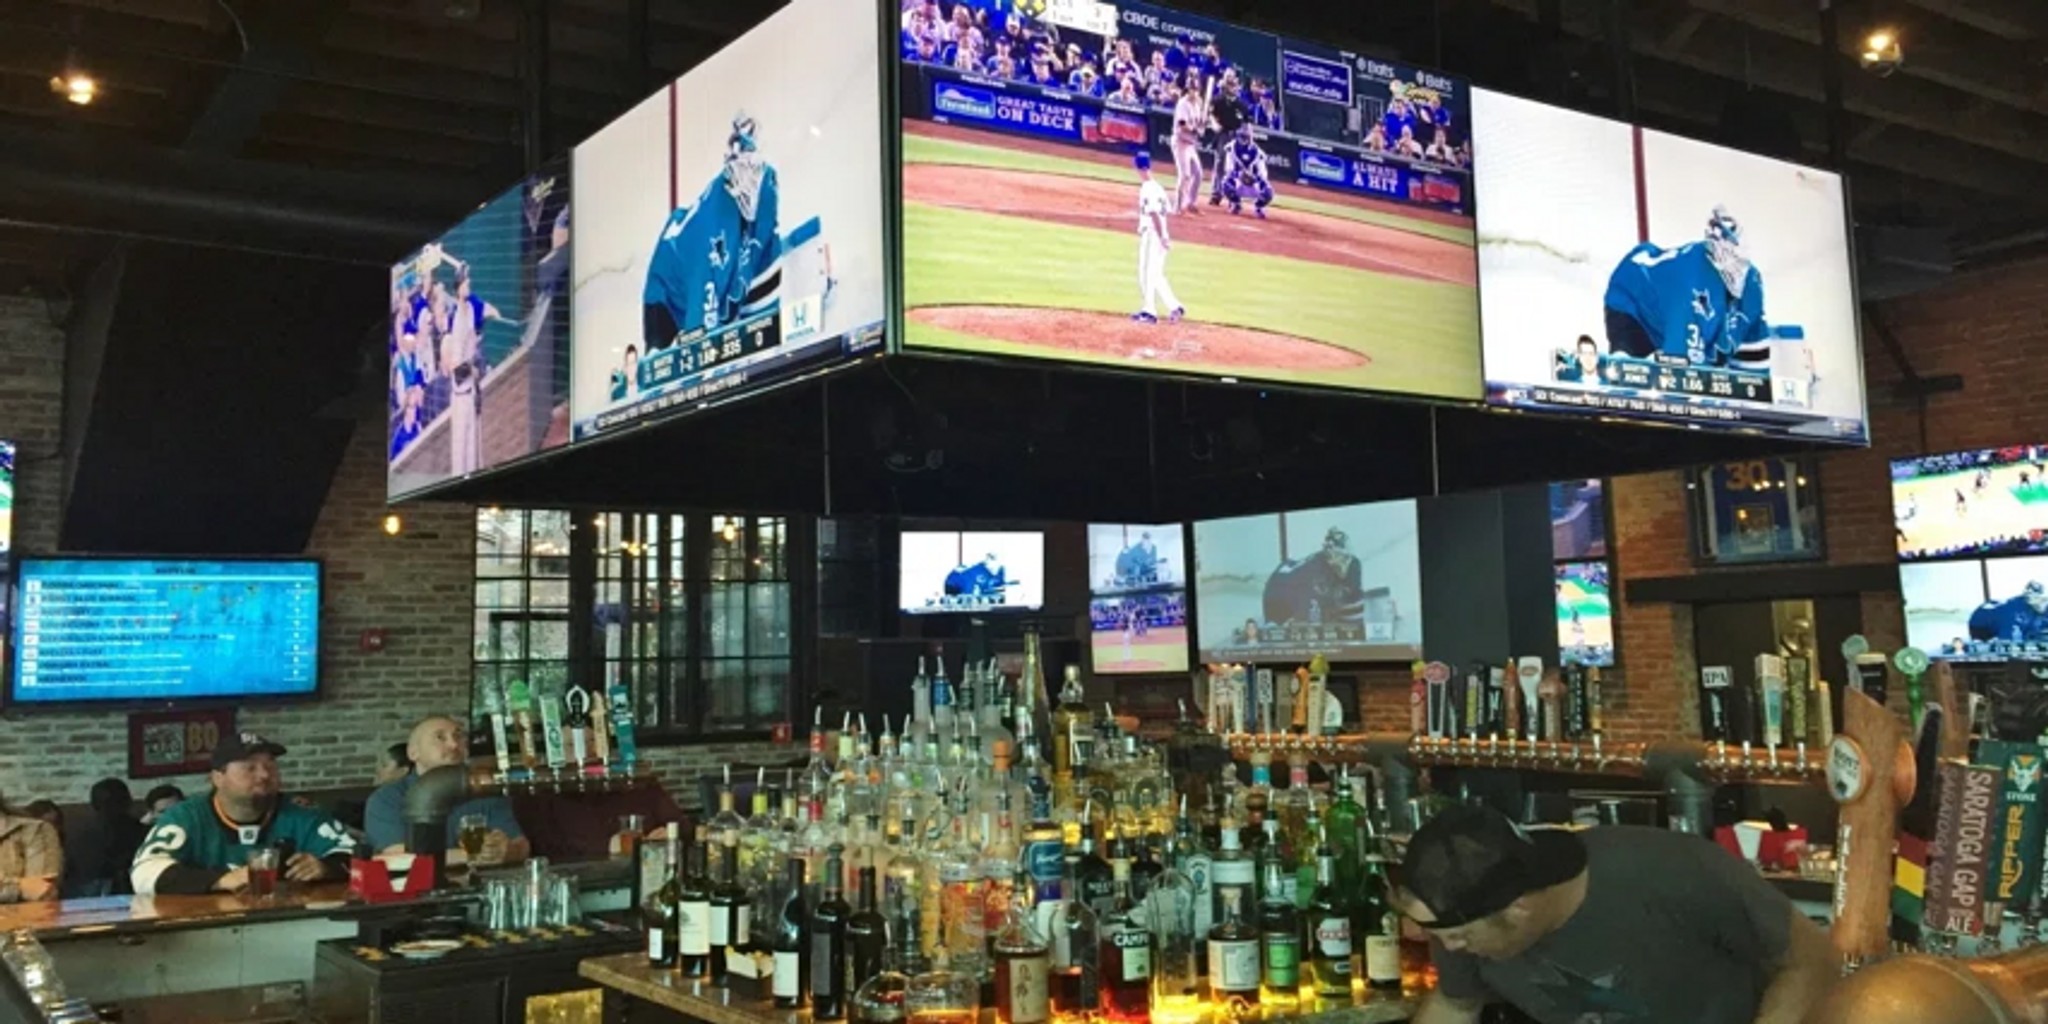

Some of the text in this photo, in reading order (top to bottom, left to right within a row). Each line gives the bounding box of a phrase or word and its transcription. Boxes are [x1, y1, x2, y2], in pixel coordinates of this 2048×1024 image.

[1122, 9, 1159, 30] CBOE
[1161, 21, 1216, 42] company
[1367, 60, 1396, 78] Bats
[1425, 73, 1453, 92] Bats
[997, 96, 1074, 117] GREAT TASTE
[997, 106, 1075, 131] ON DECK
[1352, 161, 1398, 178] ALWAYS
[1352, 171, 1398, 193] A HIT
[1725, 460, 1768, 491] 30
[1952, 771, 1992, 907] SARATOGA GAP
[1998, 804, 2026, 898] RIPPER
[1945, 912, 1974, 934] ALE
